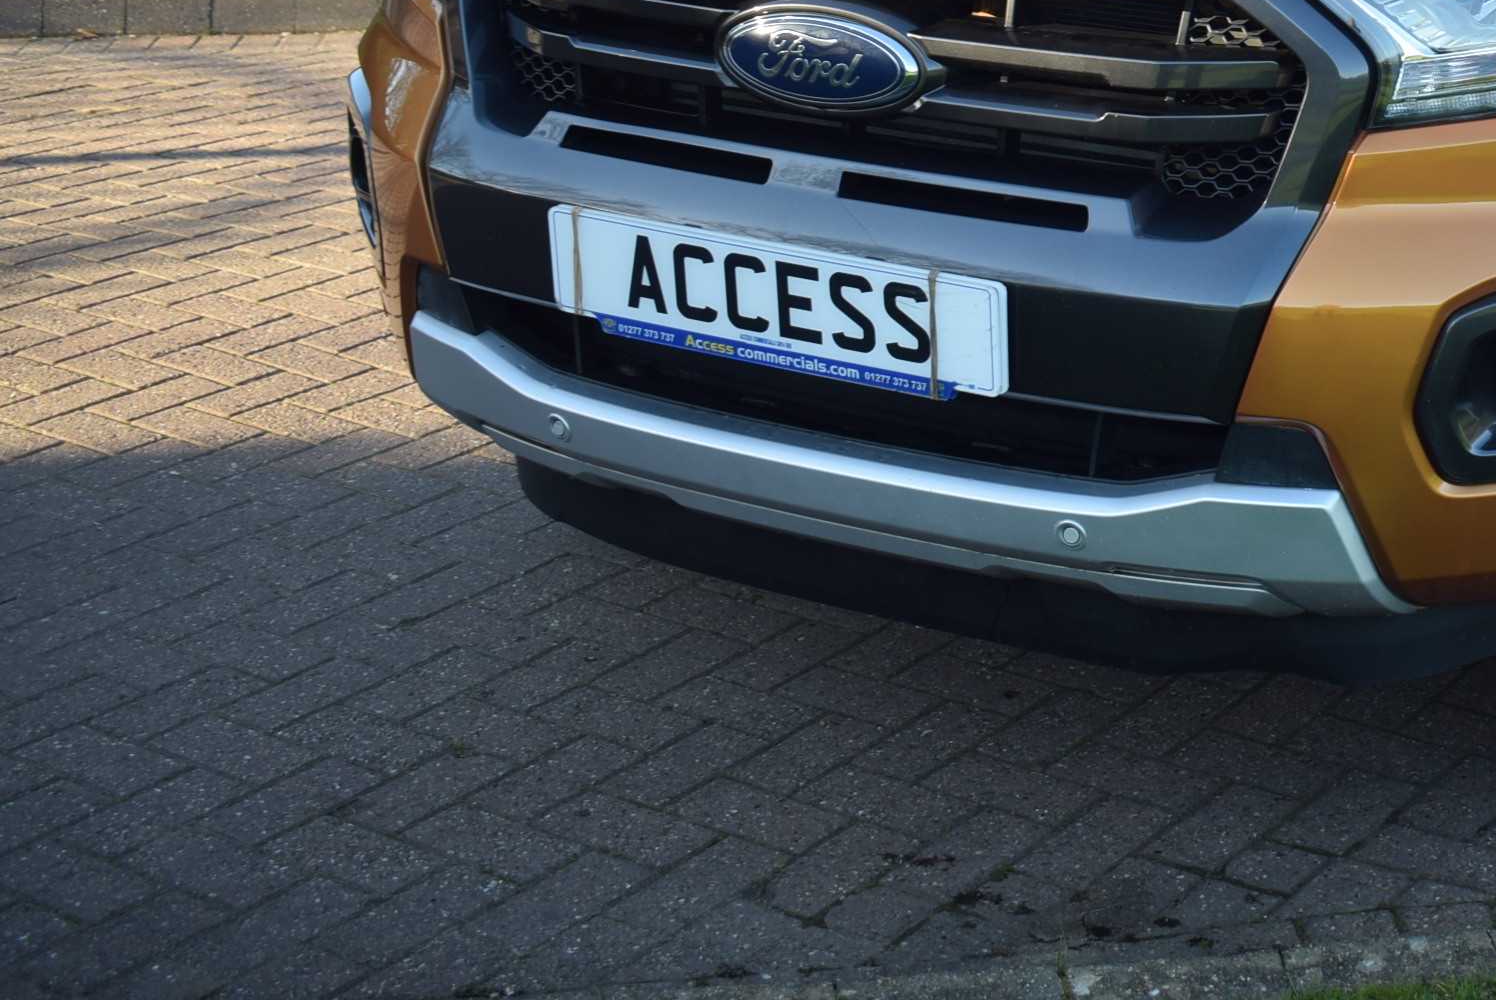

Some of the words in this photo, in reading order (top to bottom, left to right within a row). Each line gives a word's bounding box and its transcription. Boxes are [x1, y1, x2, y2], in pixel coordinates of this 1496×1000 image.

[757, 29, 864, 88] Ford
[627, 234, 932, 364] ACCESS
[618, 323, 642, 336] 01277
[643, 328, 659, 340] 373
[660, 331, 675, 342] 737
[737, 346, 860, 380] commercials.com
[864, 371, 891, 384] 01277
[893, 376, 909, 388] 373
[910, 379, 927, 391] 737
